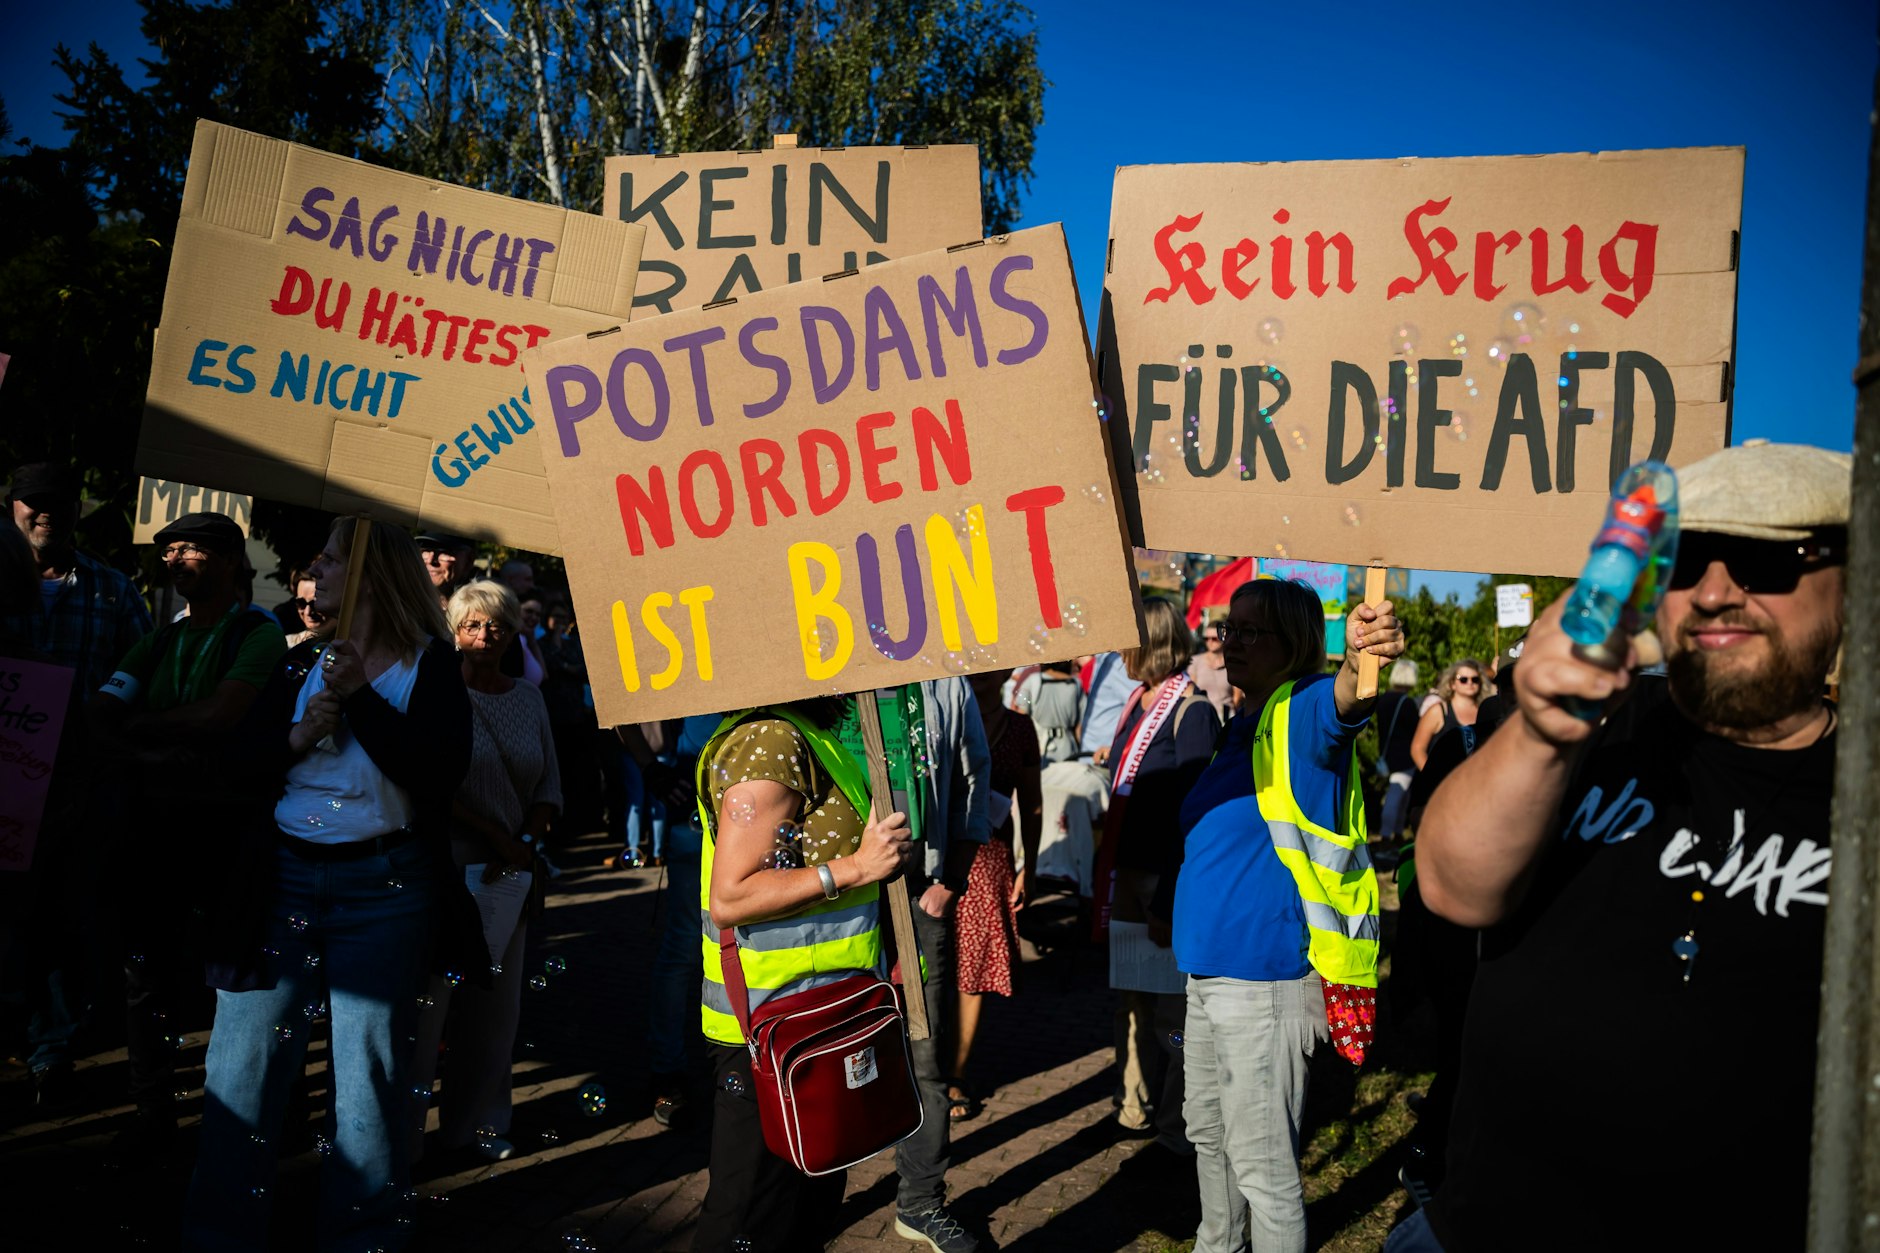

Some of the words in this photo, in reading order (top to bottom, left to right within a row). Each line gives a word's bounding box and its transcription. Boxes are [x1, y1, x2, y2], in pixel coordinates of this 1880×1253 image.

[288, 187, 398, 261] SAG
[409, 212, 555, 298] NICHT
[620, 161, 891, 250] KEIN
[1143, 208, 1357, 306] Kein
[1387, 196, 1660, 319] Krug
[271, 266, 351, 331] DU
[358, 288, 551, 371] HÄTTEST
[545, 255, 1049, 458] POTSDAMS
[188, 340, 256, 393] ES
[270, 352, 421, 417] NICHT
[1132, 344, 1291, 483] FÜR
[1325, 353, 1463, 490] DIE
[1479, 350, 1677, 495] AFD
[431, 386, 536, 488] GEWU
[615, 399, 972, 557] NORDEN
[612, 585, 715, 693] IST
[788, 485, 1066, 682] BUNT
[1562, 778, 1655, 845] NO
[1660, 808, 1834, 918] WAR
